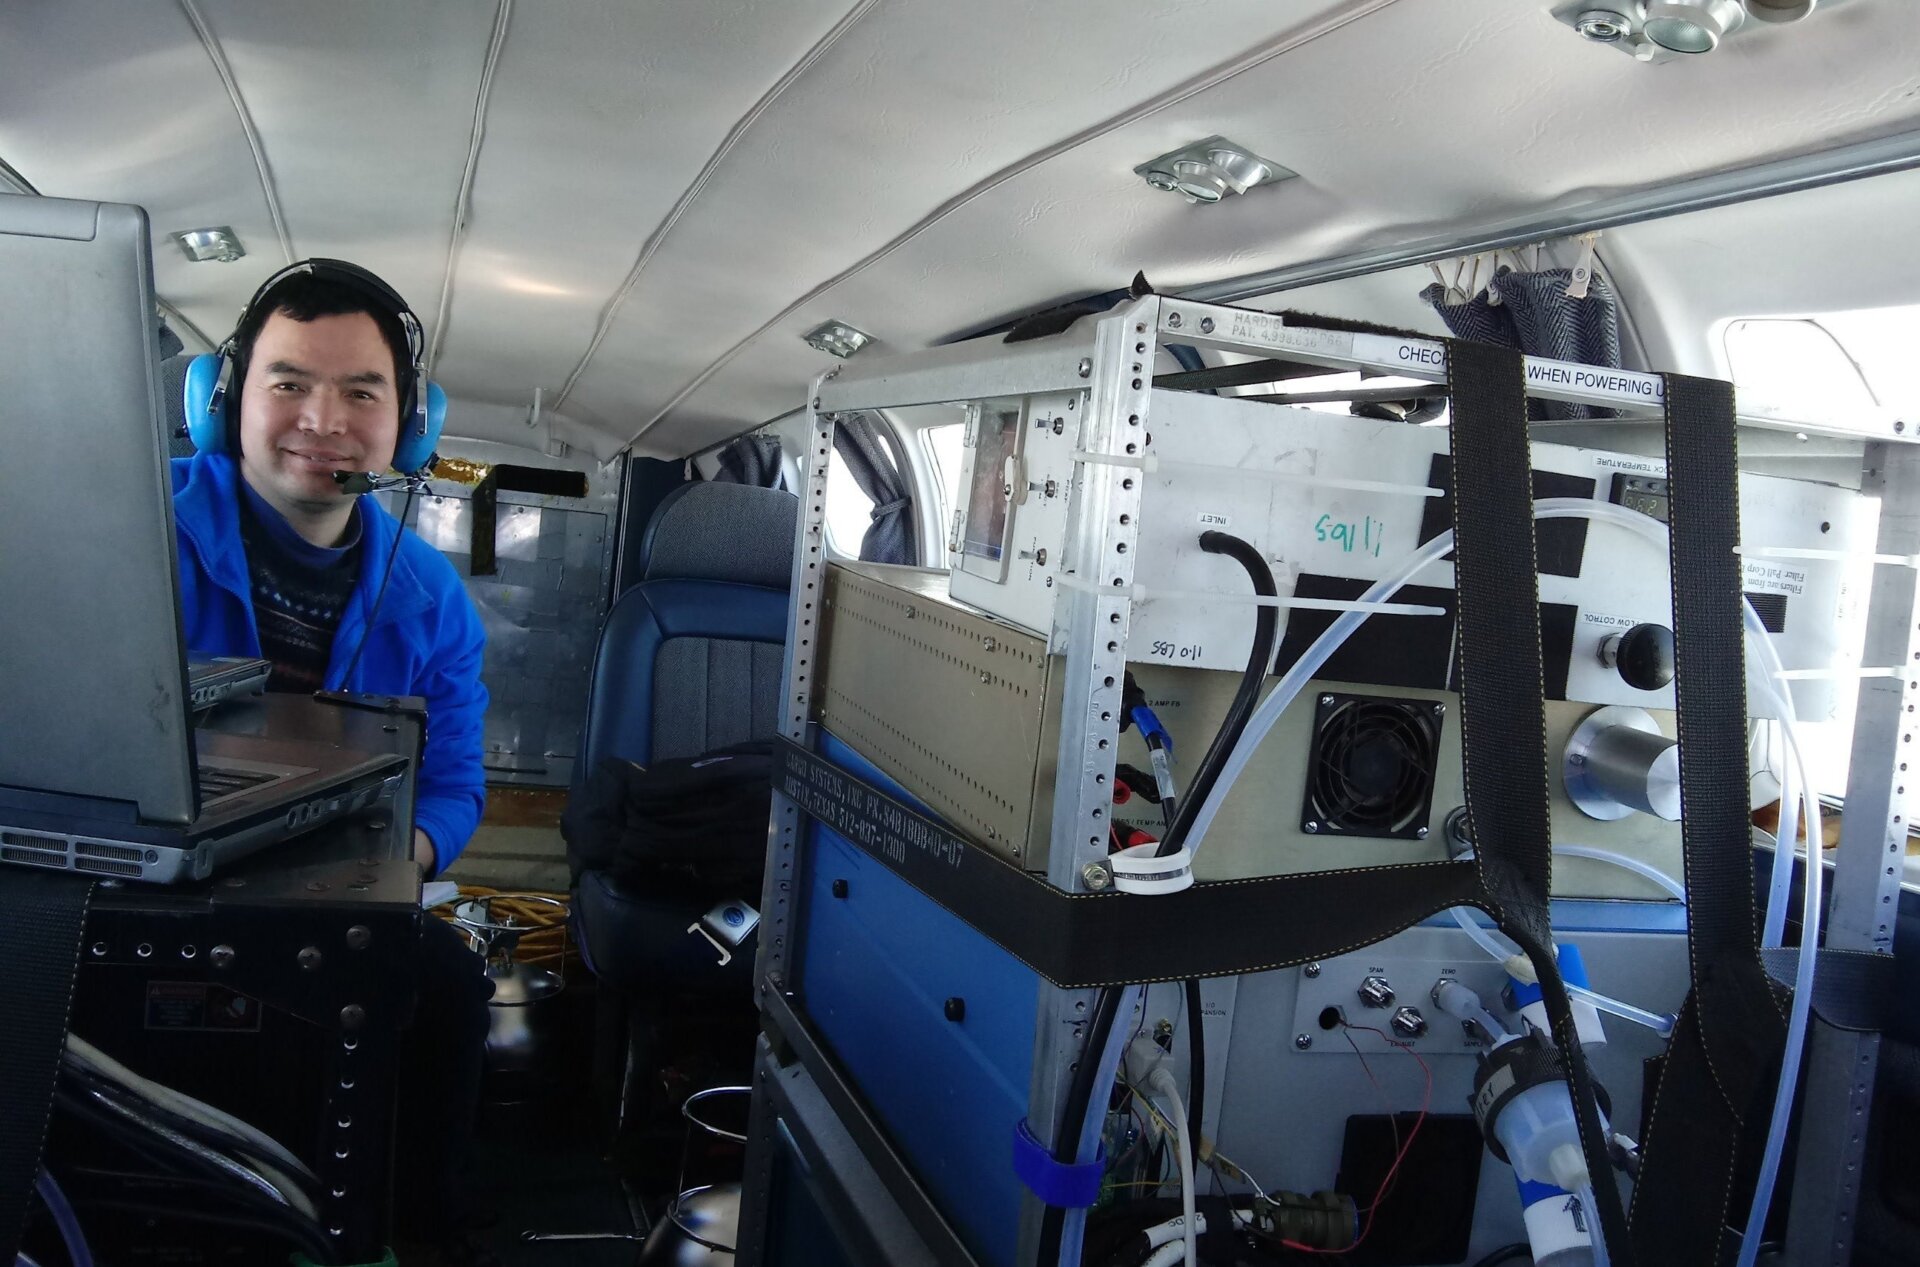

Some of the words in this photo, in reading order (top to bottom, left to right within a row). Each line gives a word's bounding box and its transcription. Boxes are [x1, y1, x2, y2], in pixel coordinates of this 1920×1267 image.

[1527, 365, 1572, 384] WHEN
[1575, 372, 1653, 396] POWERING
[1596, 457, 1651, 472] TEMPERATURE
[1200, 515, 1227, 525] INLET
[1780, 583, 1803, 595] Filters
[1584, 613, 1615, 625] COTROL
[1150, 640, 1176, 659] LBS
[1368, 966, 1384, 974] SPAN
